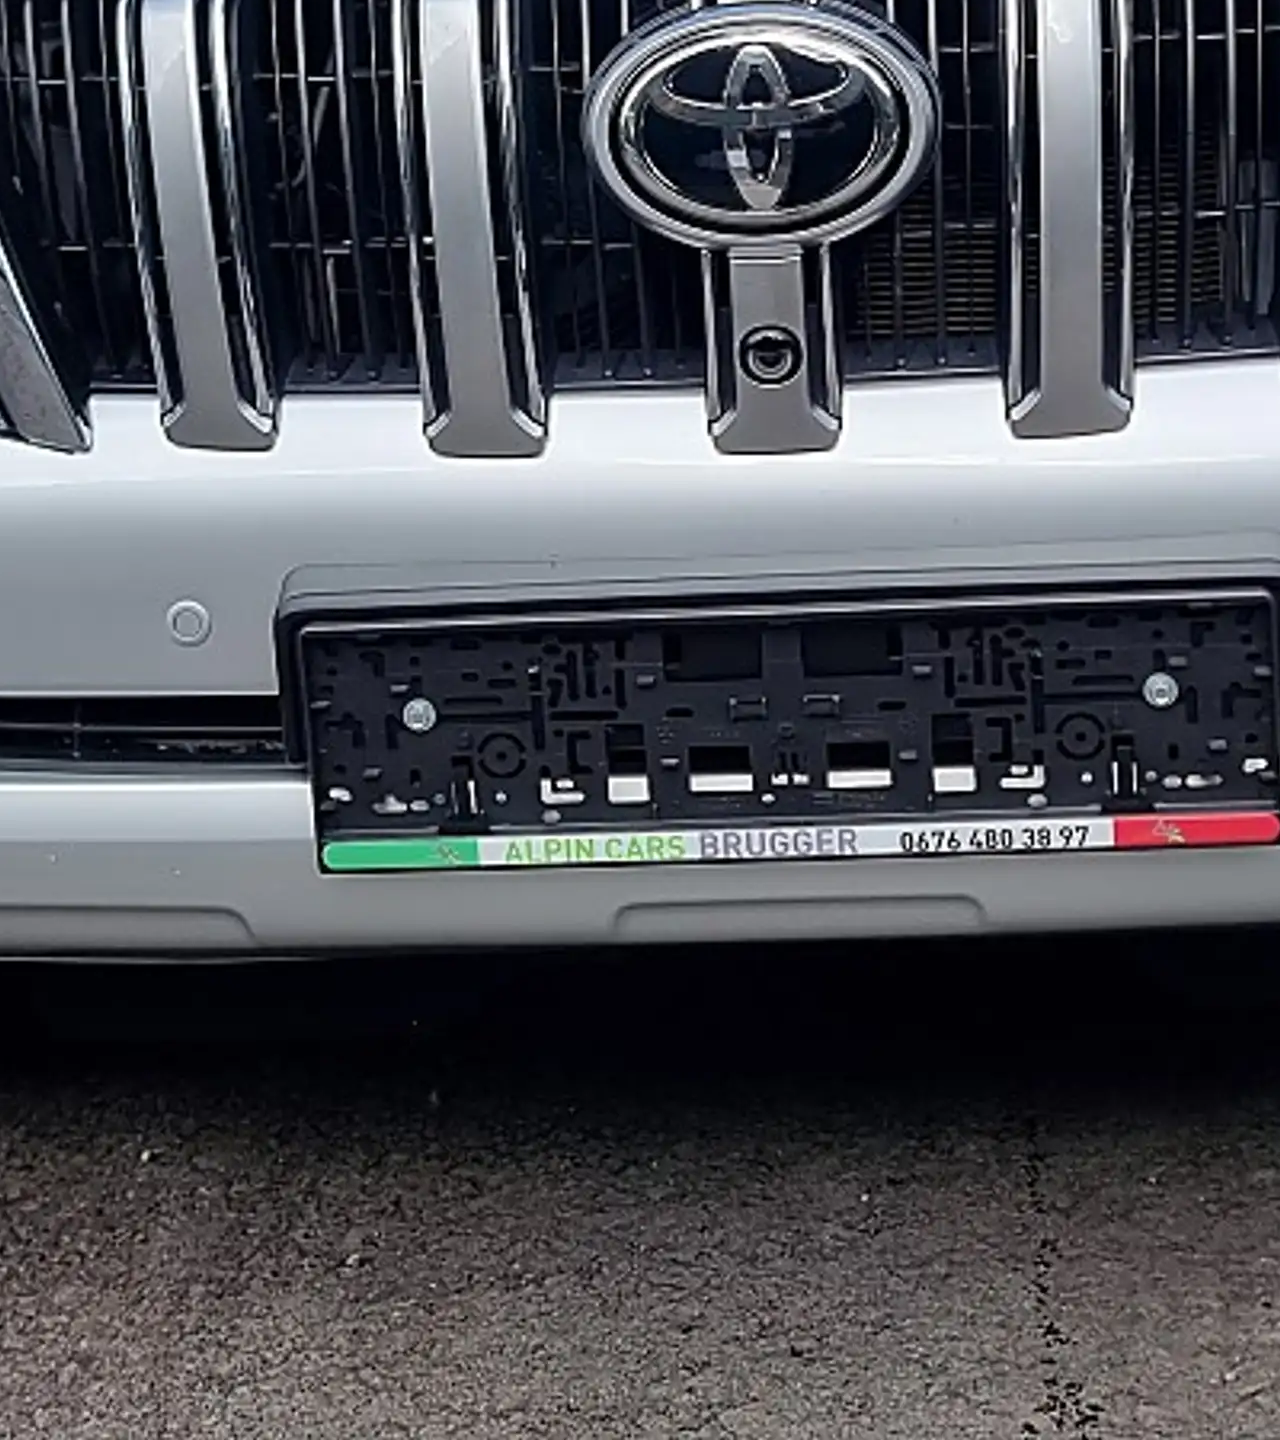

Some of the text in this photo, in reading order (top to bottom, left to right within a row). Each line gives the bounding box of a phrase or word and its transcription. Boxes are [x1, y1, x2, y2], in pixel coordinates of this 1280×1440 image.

[504, 825, 1090, 864] ALPIN CARS BRUGGER 0676 480 38 97
